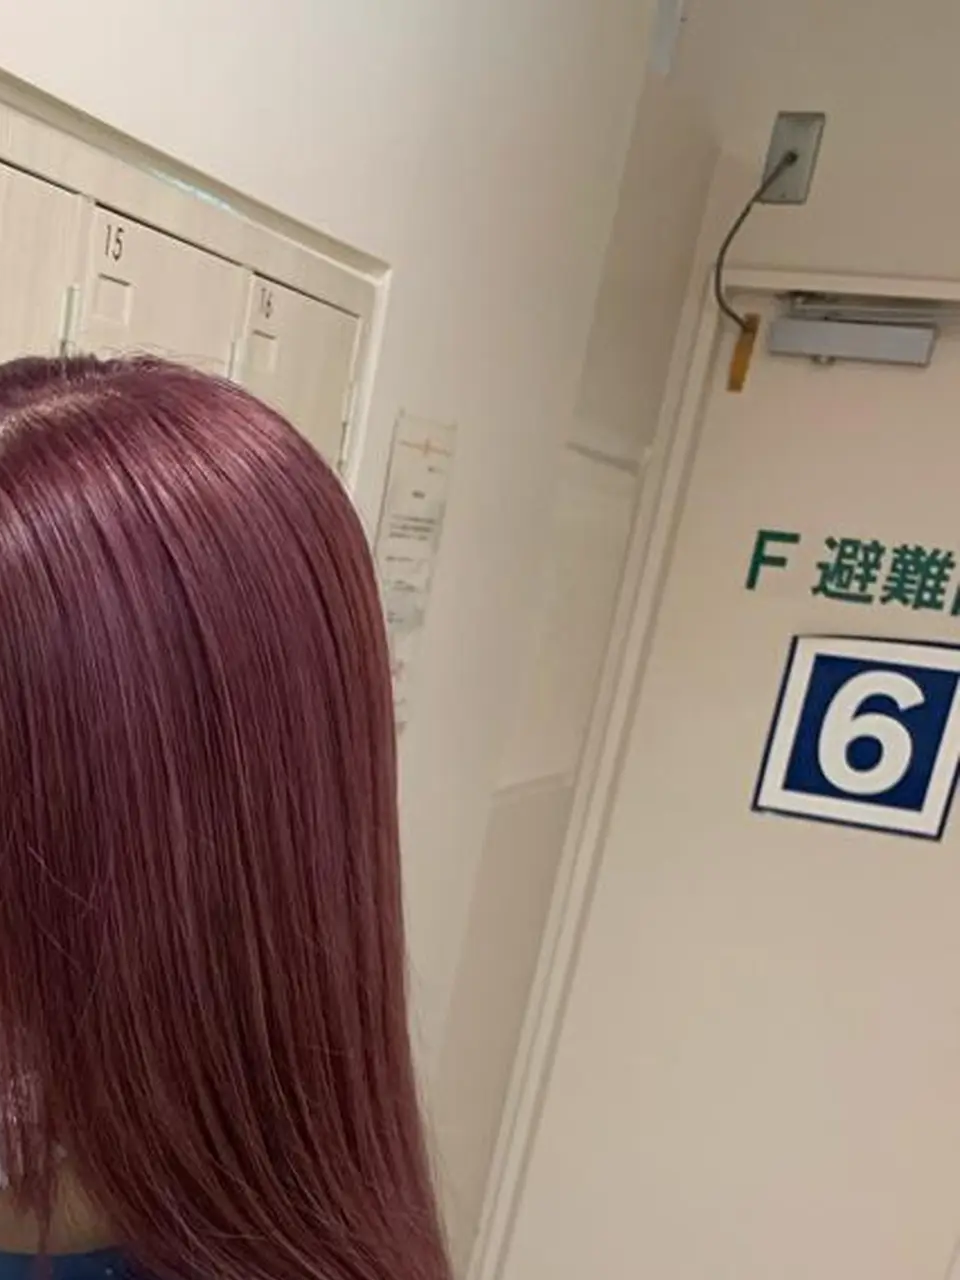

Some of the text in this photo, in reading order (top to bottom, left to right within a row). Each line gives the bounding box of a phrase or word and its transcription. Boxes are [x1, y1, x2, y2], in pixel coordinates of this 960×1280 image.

[103, 225, 125, 262] 15
[745, 528, 960, 616] F 避難
[818, 669, 925, 796] 6
